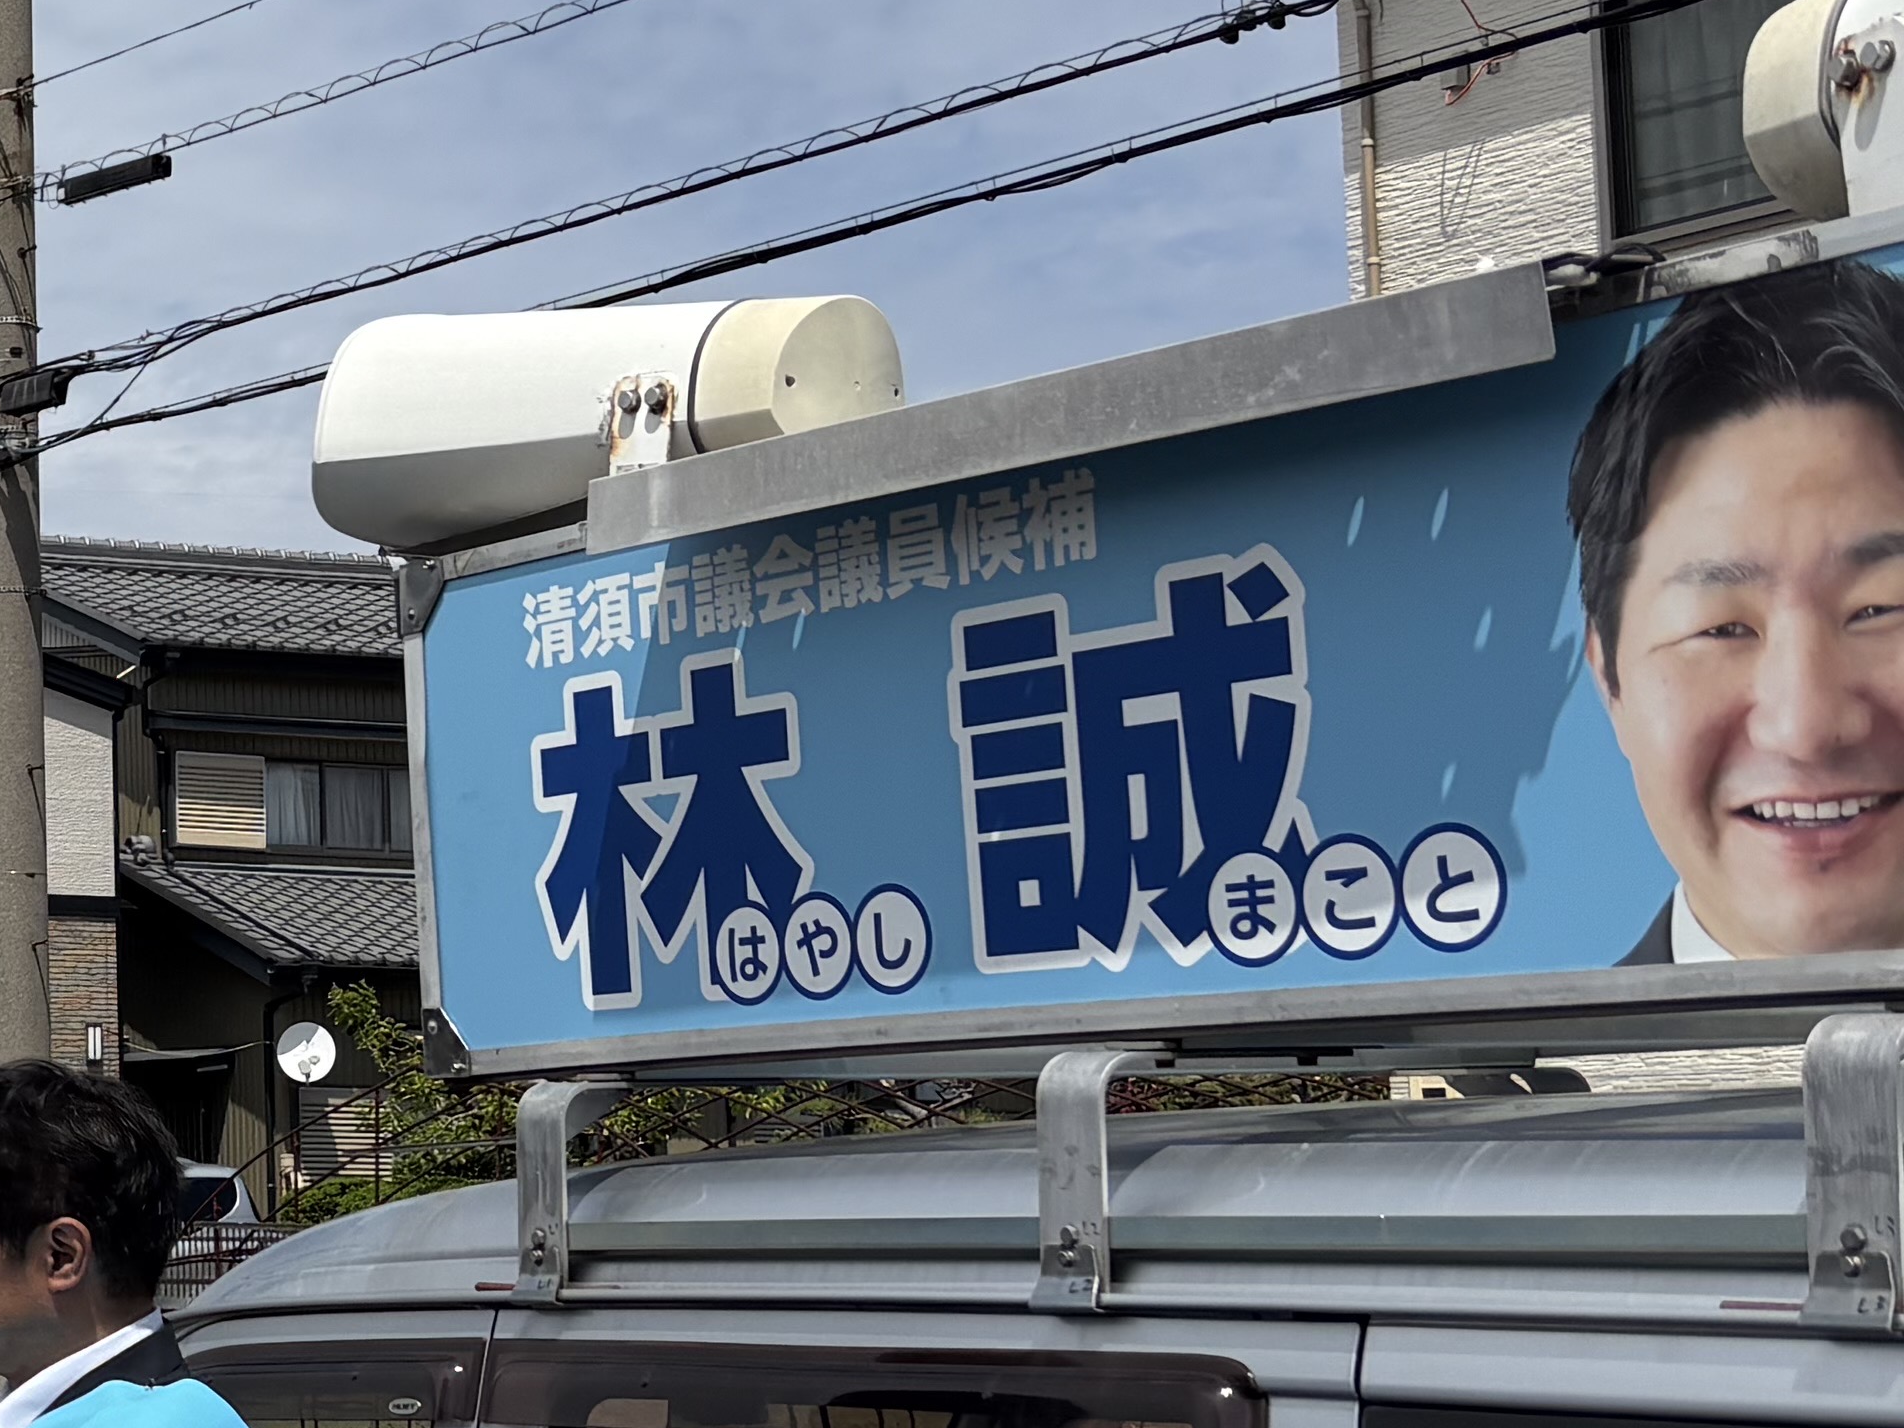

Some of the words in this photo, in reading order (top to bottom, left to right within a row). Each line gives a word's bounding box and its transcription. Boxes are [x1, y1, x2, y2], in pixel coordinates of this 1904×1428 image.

[522, 468, 1097, 670] 清須市議会議員候補
[533, 652, 803, 1008] 林
[948, 544, 1309, 972] 誠
[721, 898, 922, 994] はやし
[1215, 836, 1494, 954] まこと
